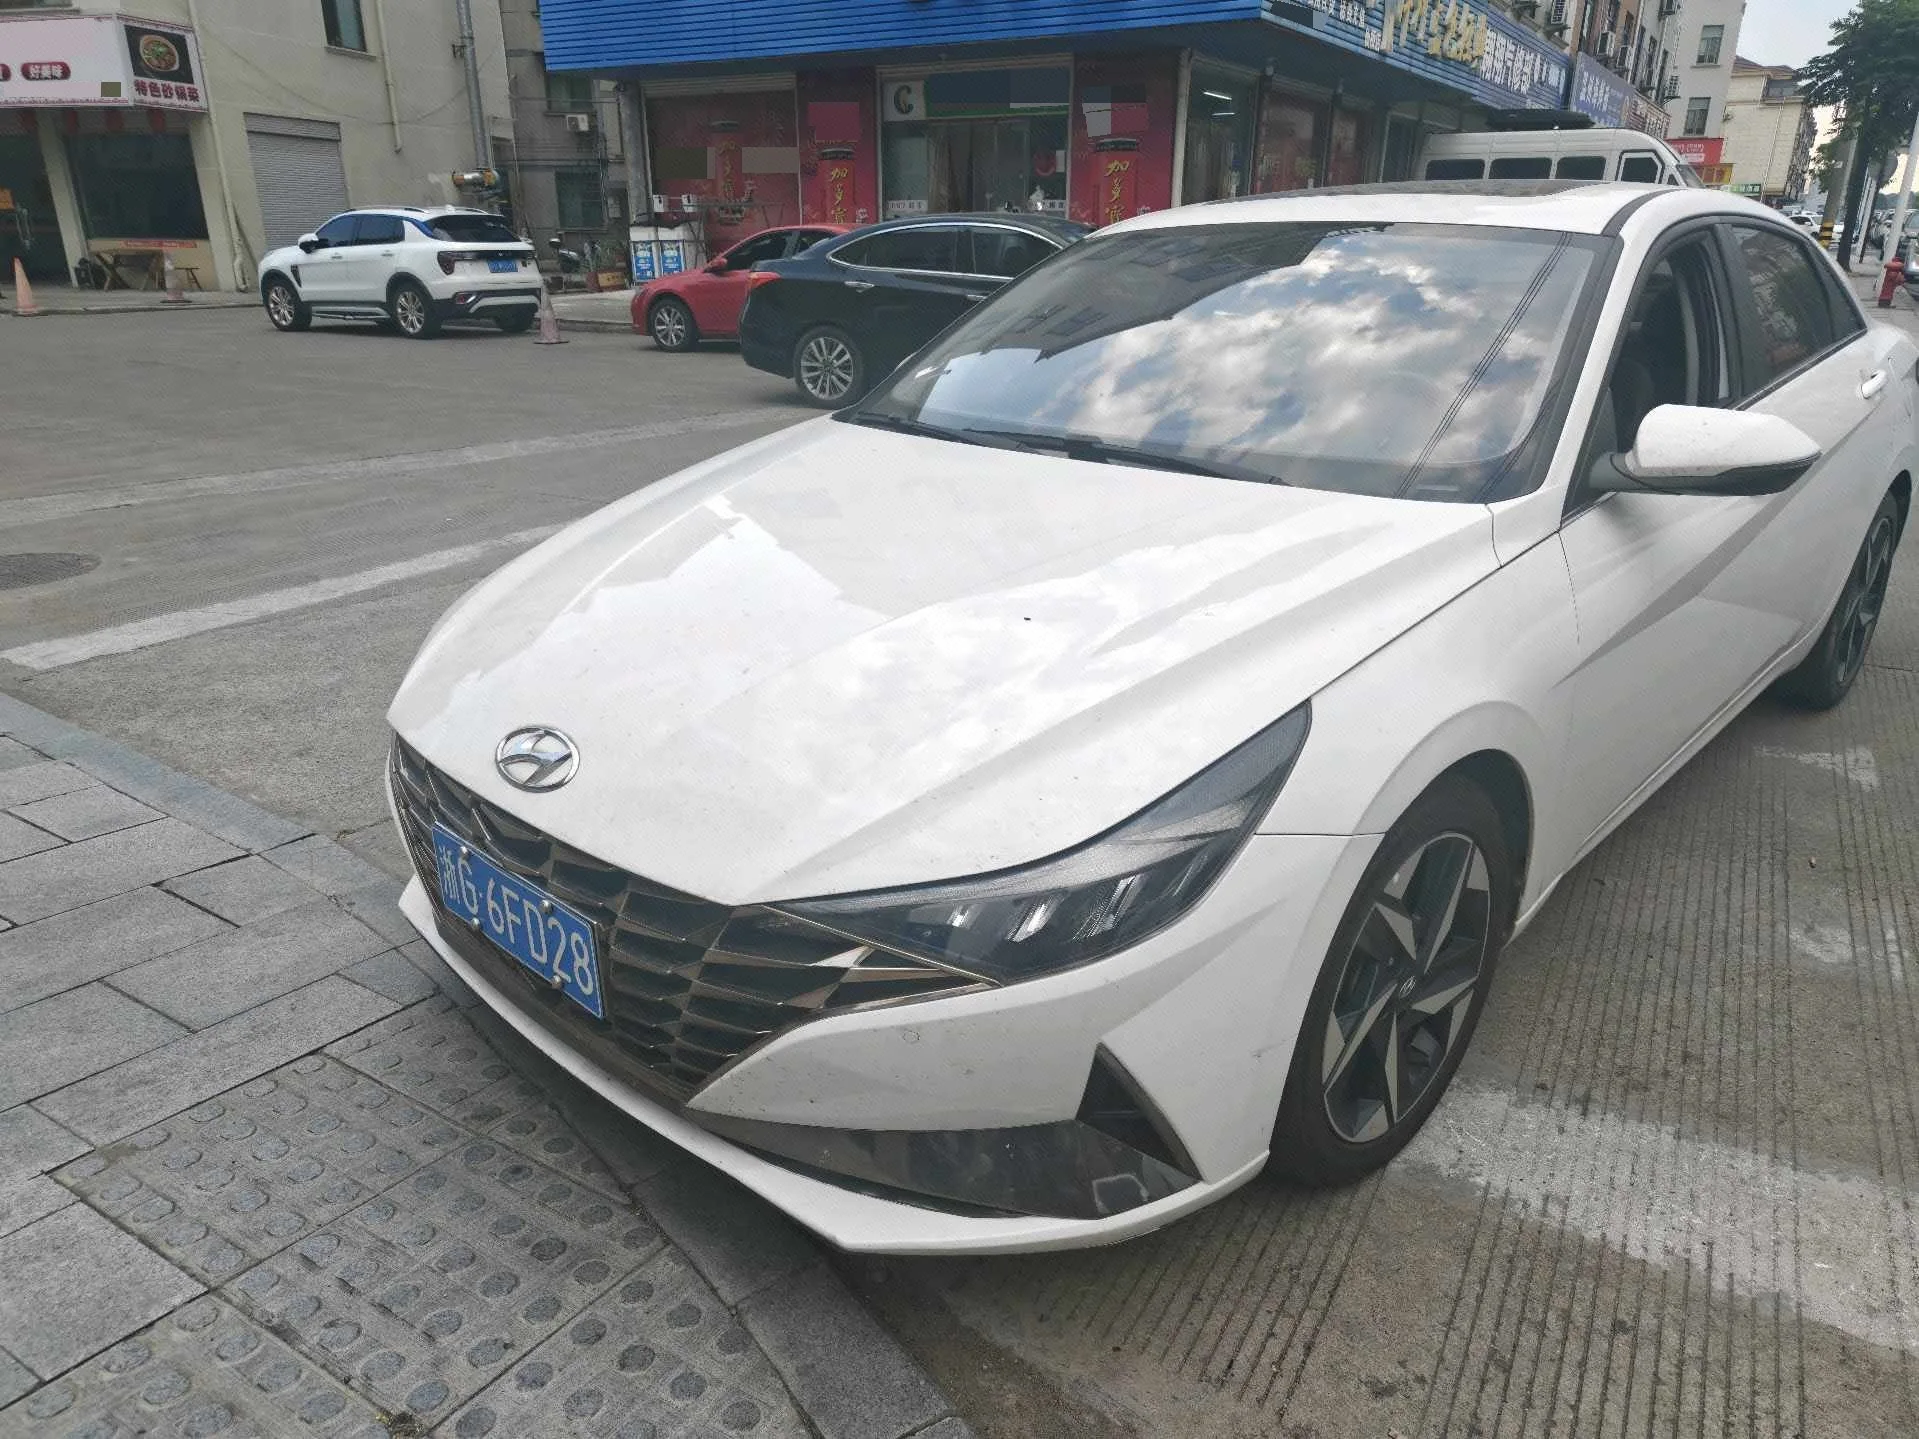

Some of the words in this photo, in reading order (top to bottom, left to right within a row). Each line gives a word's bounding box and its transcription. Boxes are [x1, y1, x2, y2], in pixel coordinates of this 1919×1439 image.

[134, 79, 200, 102] 特色砂锅菜
